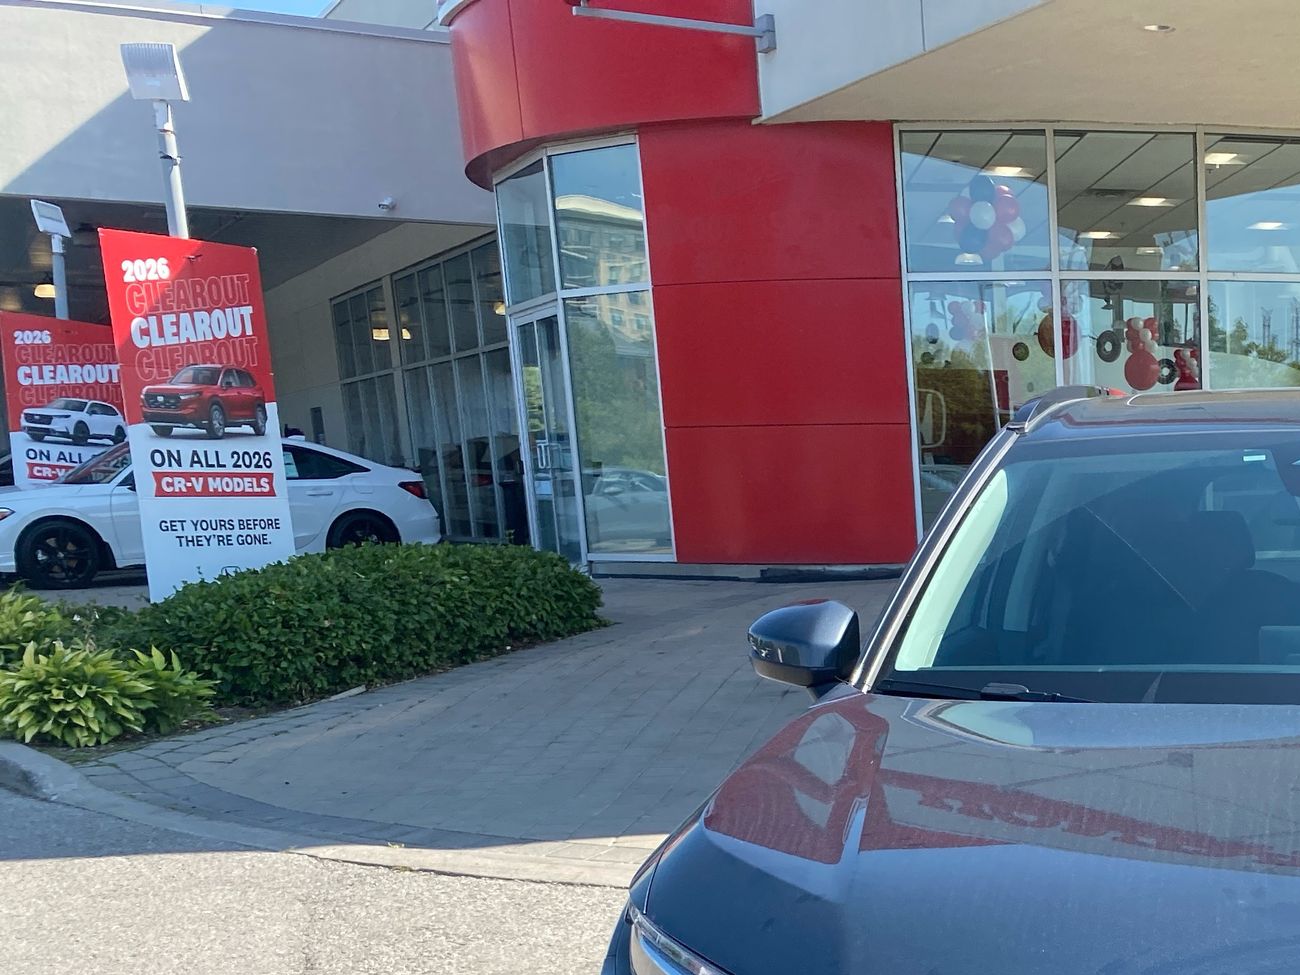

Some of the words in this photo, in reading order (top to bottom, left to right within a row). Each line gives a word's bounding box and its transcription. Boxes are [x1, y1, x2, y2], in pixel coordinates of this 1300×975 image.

[122, 257, 170, 282] 2026
[126, 274, 249, 316] CLEAROUT
[131, 306, 253, 348] CLEAROUT
[13, 330, 52, 345] 2026
[15, 343, 119, 365] CLEAROUT
[17, 364, 121, 386] CLEAROUT
[25, 448, 50, 461] ON
[56, 451, 83, 464] ALL
[150, 449, 182, 468] ON
[189, 450, 227, 468] ALL
[230, 451, 273, 469] 2026
[32, 466, 65, 478] CR-V
[161, 477, 204, 493] CR-V
[208, 477, 270, 493] MODELS
[159, 520, 187, 532] GET
[190, 519, 235, 532] YOURS
[238, 518, 281, 531] BEFORE
[176, 534, 233, 547] THEY'RE
[236, 533, 272, 546] GONE.
